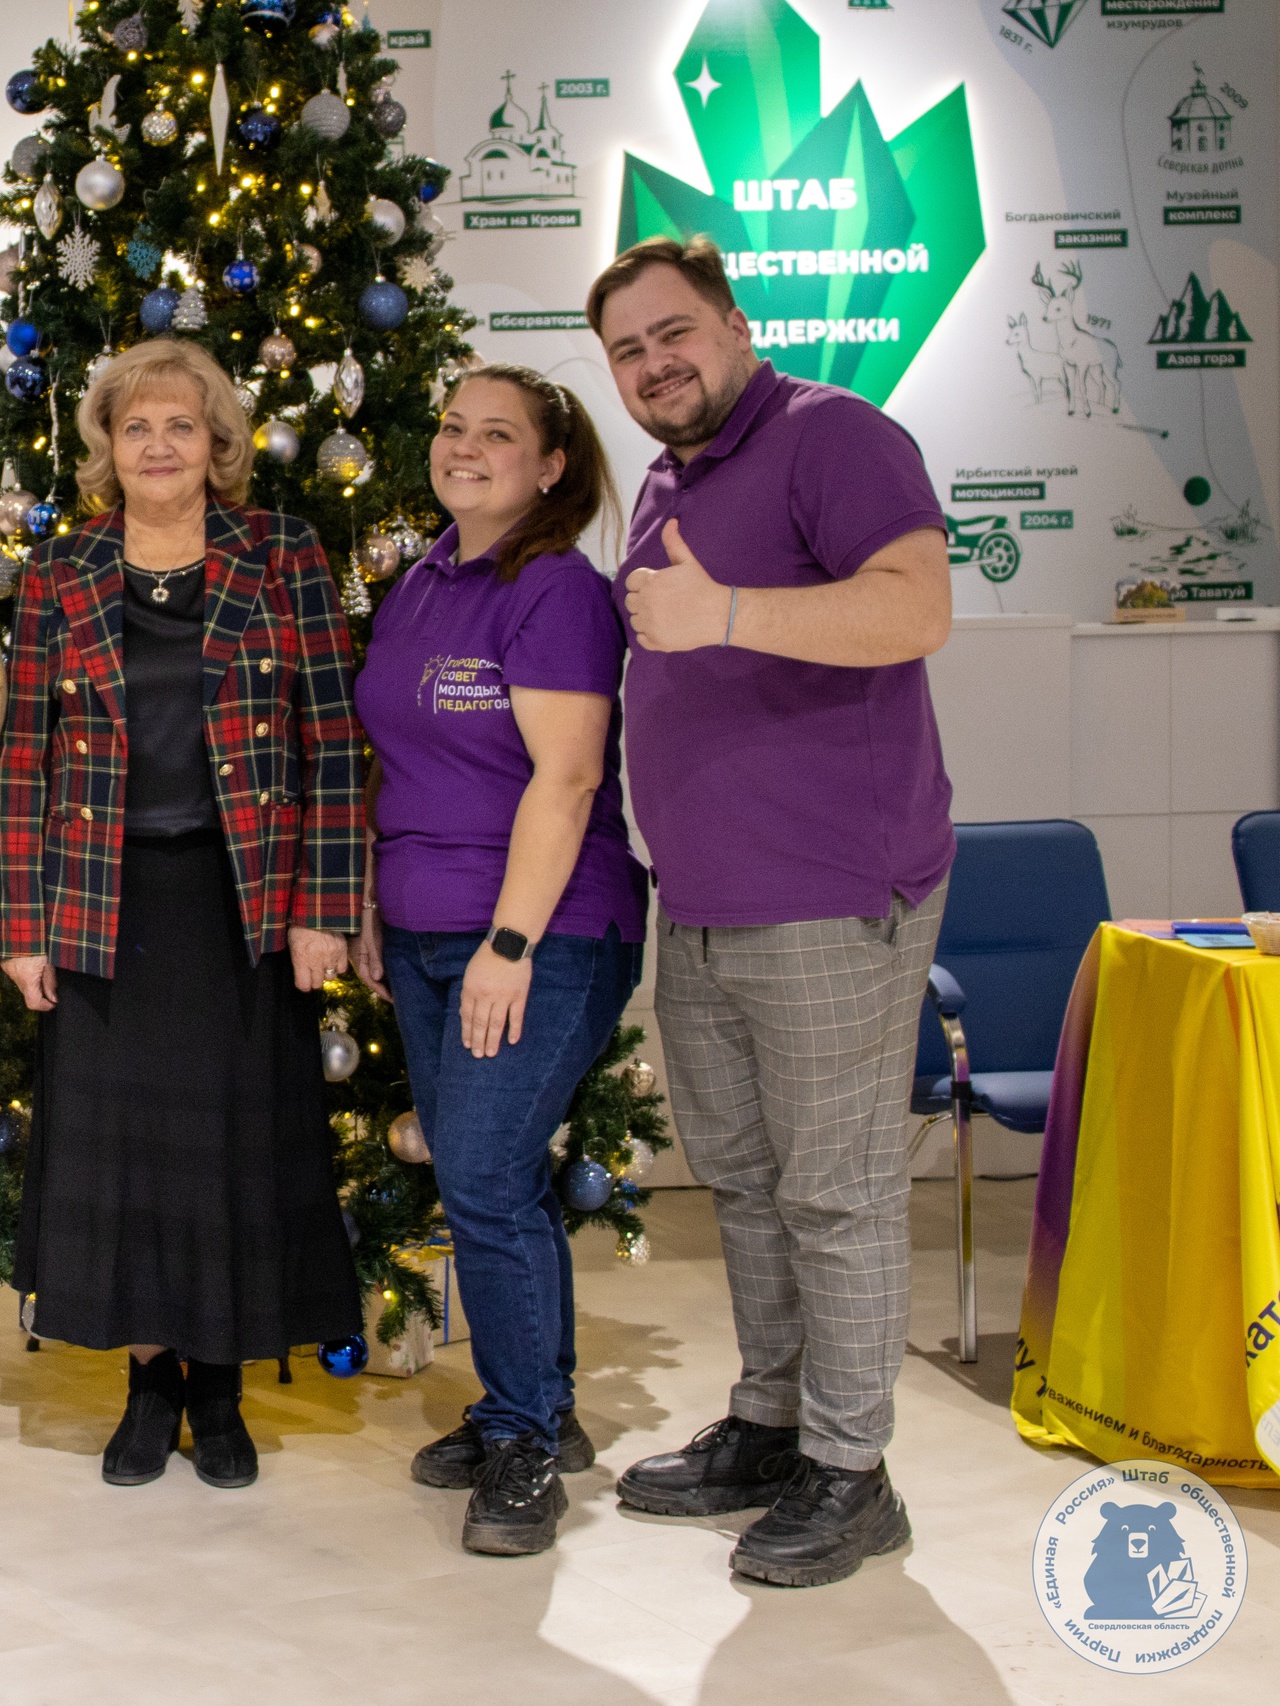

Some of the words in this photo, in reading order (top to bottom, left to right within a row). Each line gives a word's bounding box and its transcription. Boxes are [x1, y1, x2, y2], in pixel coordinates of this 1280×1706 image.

[1107, 19, 1183, 31] изумрудов
[390, 33, 425, 47] край
[559, 83, 593, 94] 2003
[1220, 82, 1249, 109] 2009
[733, 178, 857, 211] ШТАБ
[1166, 189, 1239, 202] Музейный
[470, 215, 507, 228] Храм
[510, 216, 527, 225] на
[531, 214, 576, 227] Крови
[1005, 208, 1122, 223] Богдановичский
[1169, 209, 1237, 221] комплекс
[1058, 233, 1122, 244] заказник
[493, 315, 587, 328] обсерватори
[1086, 313, 1112, 330] 1971
[748, 317, 900, 348] ДДЕРЖКИ
[1166, 353, 1201, 365] Азов
[1204, 354, 1235, 366] гора
[956, 466, 1033, 480] Ирбитский
[1036, 465, 1079, 478] музей
[956, 487, 1040, 499] мотоциклов
[1025, 515, 1058, 526] 2004
[1191, 585, 1246, 599] Таватуй
[441, 670, 477, 682] СОВЕТ
[438, 683, 501, 698] МОЛОДЫХ
[438, 698, 510, 712] ПЕДАГОГОВ
[1128, 1427, 1139, 1440] и
[1142, 1431, 1273, 1471] благодарность
